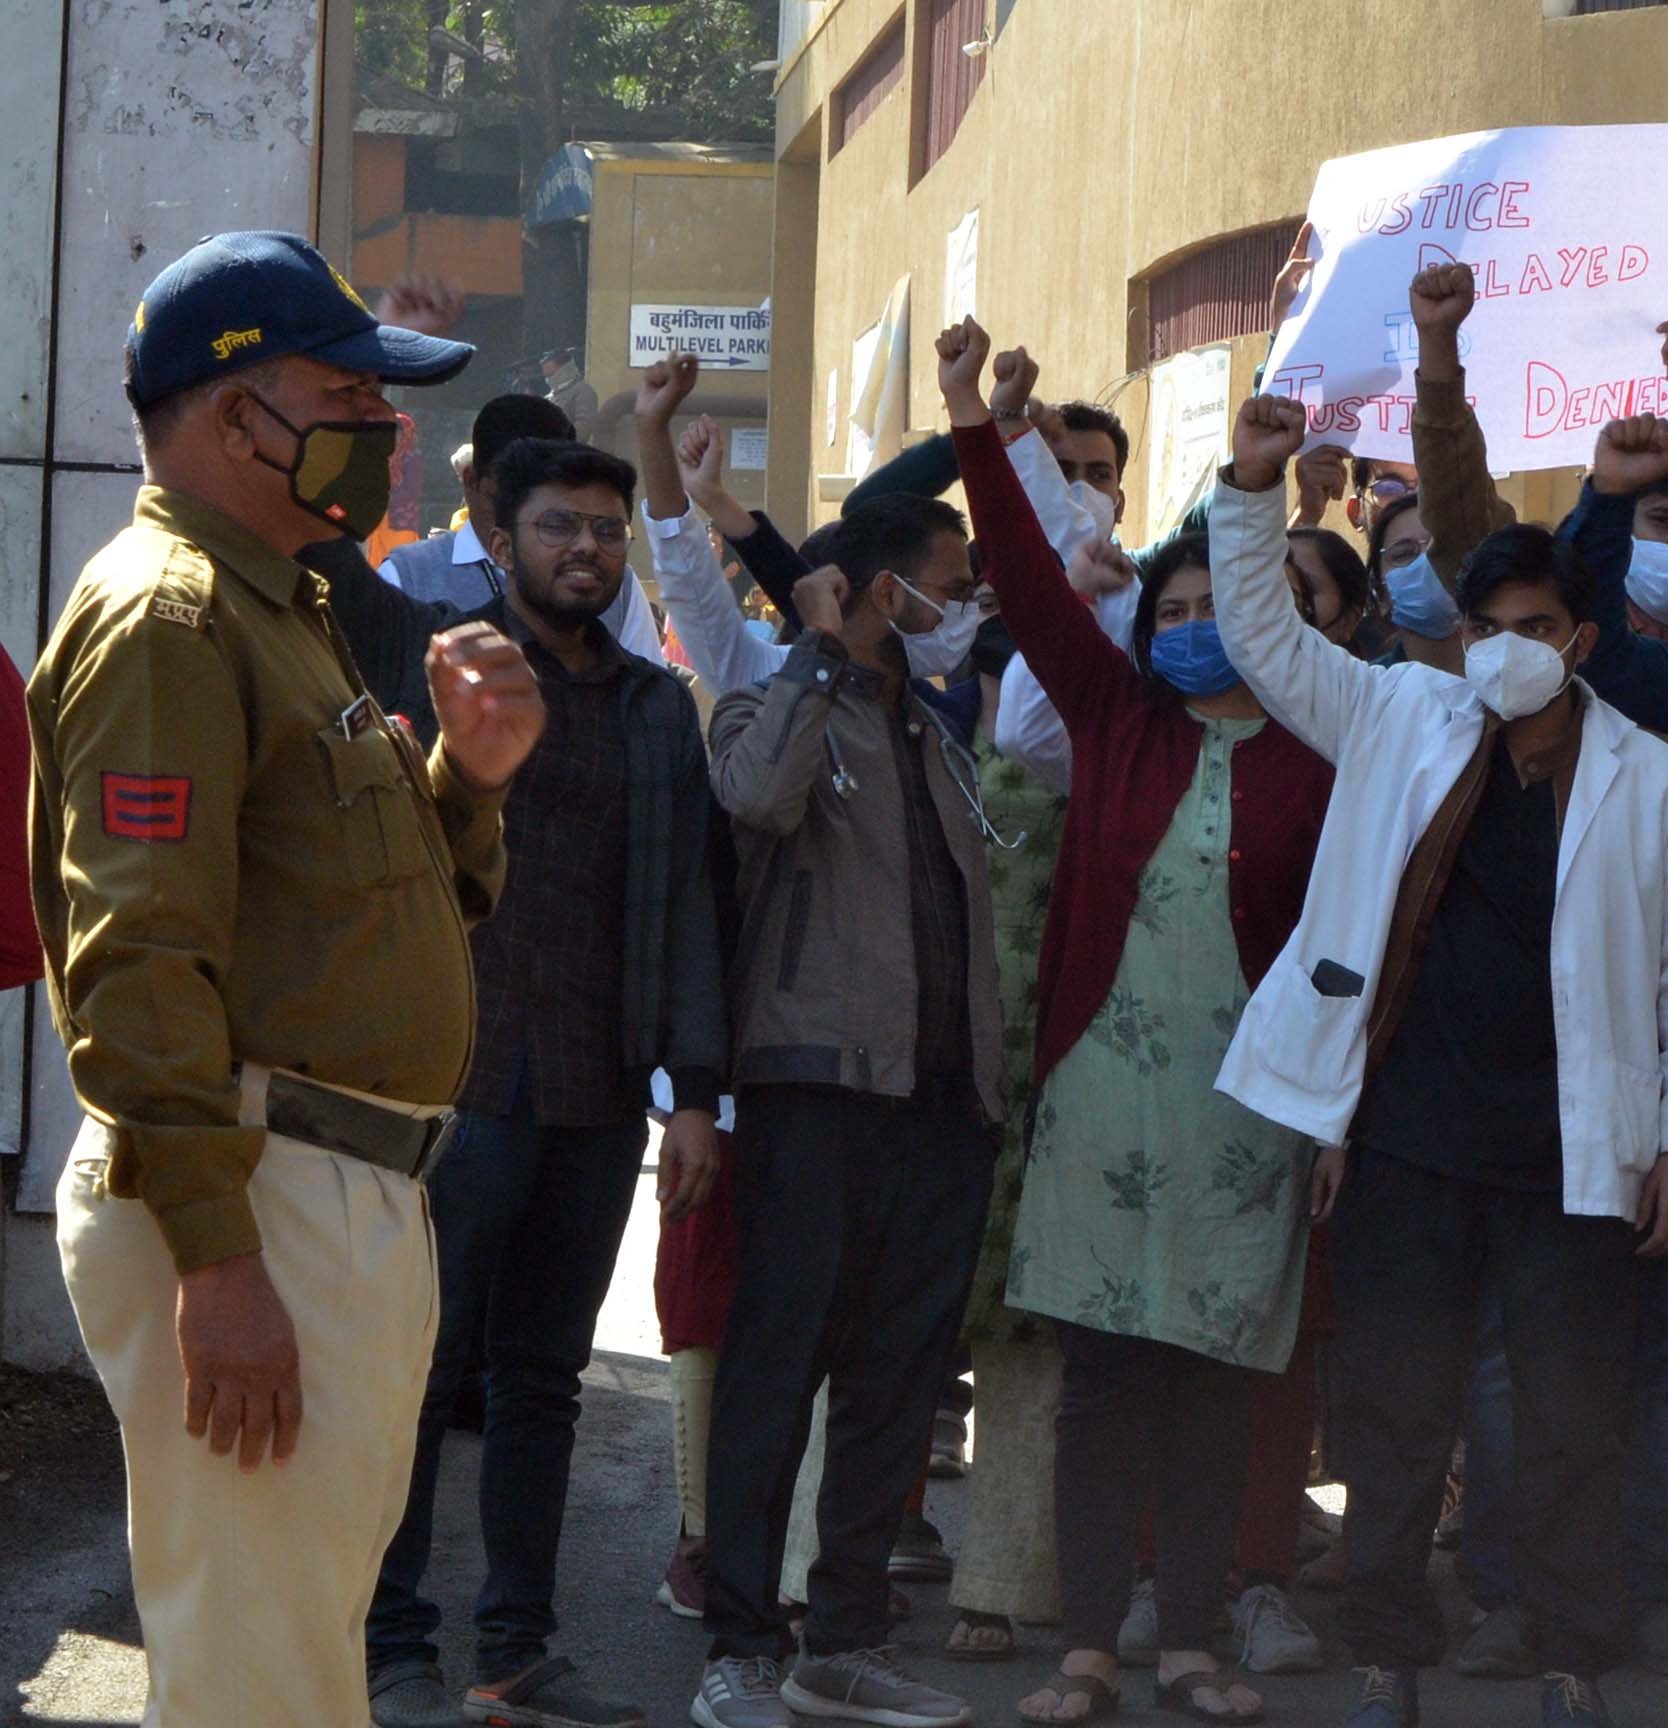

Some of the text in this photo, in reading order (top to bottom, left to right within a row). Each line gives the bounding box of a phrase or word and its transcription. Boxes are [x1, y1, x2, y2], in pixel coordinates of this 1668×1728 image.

[1320, 181, 1530, 236] USTICE
[649, 309, 769, 334] बहुमंजिला पार्कि
[1384, 312, 1472, 362] I
[210, 328, 262, 360] पुलिस
[636, 336, 769, 354] MULTILEVEL PARK
[1273, 364, 1477, 434] JUSTI
